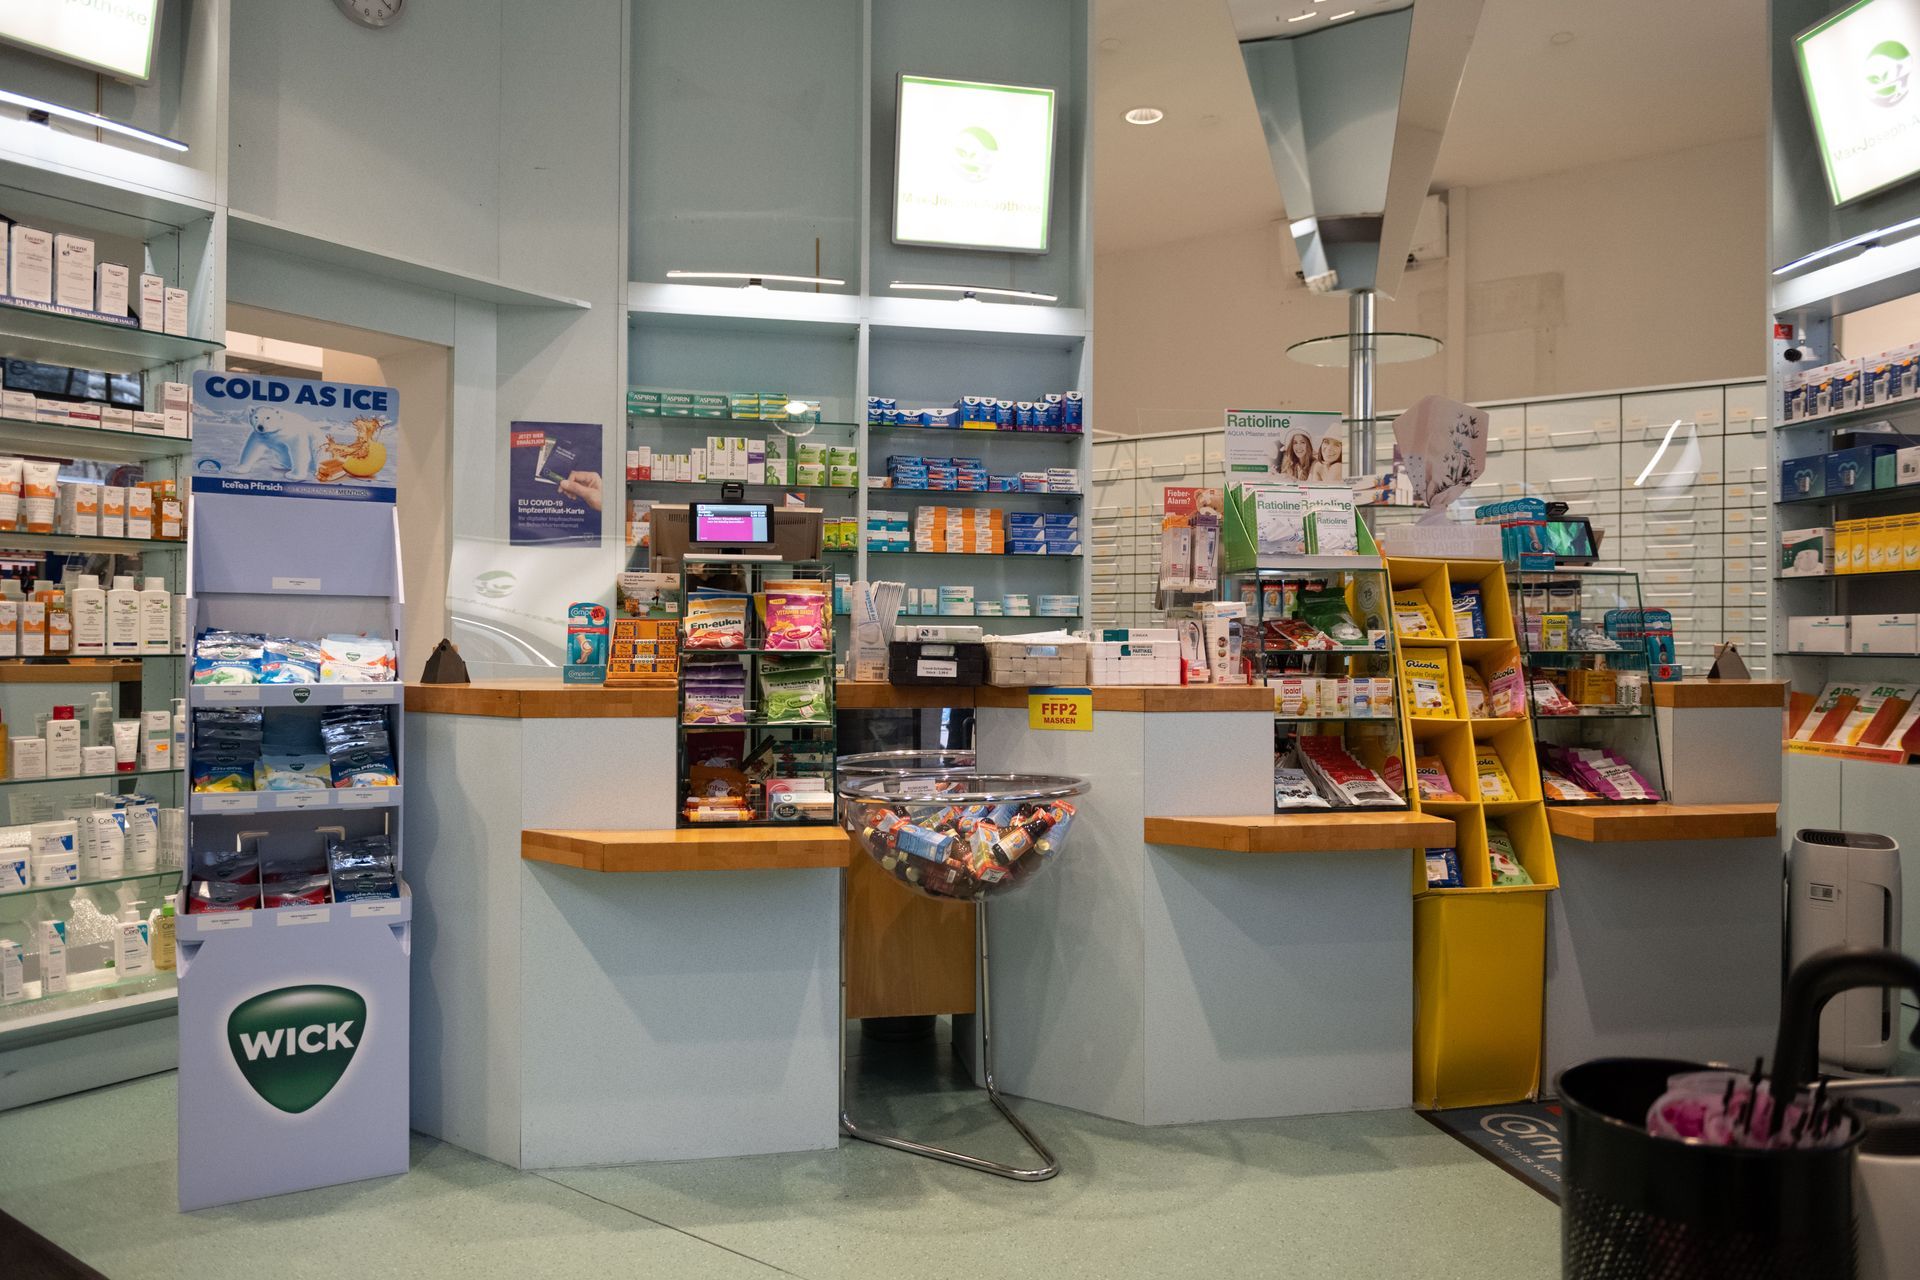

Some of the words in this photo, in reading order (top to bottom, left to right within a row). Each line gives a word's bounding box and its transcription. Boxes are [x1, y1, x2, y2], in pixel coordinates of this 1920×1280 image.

[205, 376, 290, 403] COLD
[295, 384, 337, 408] AS
[343, 388, 388, 411] ICE
[1227, 414, 1290, 429] Ratioline
[222, 480, 249, 491] IceTea
[250, 481, 283, 492] Pfirsich
[1167, 489, 1191, 497] Fieber-
[530, 499, 564, 507] COVID-19
[1167, 497, 1191, 505] Alarm?
[1257, 500, 1300, 511] Ratioline
[518, 506, 585, 516] Impfzertifikat-Karte
[1317, 517, 1348, 525] Ratioline
[571, 607, 590, 618] Comp
[690, 619, 742, 629] Em-eukal
[1406, 659, 1440, 670] Ricola
[1830, 687, 1861, 696] ABC
[1872, 686, 1906, 697] ABC
[1041, 703, 1077, 716] FFP2
[134, 808, 158, 819] CeraVe
[98, 816, 124, 826] CeraVe
[124, 925, 148, 936] CeraVe
[239, 1020, 355, 1061] WICK
[1492, 1138, 1535, 1163] Nichts
